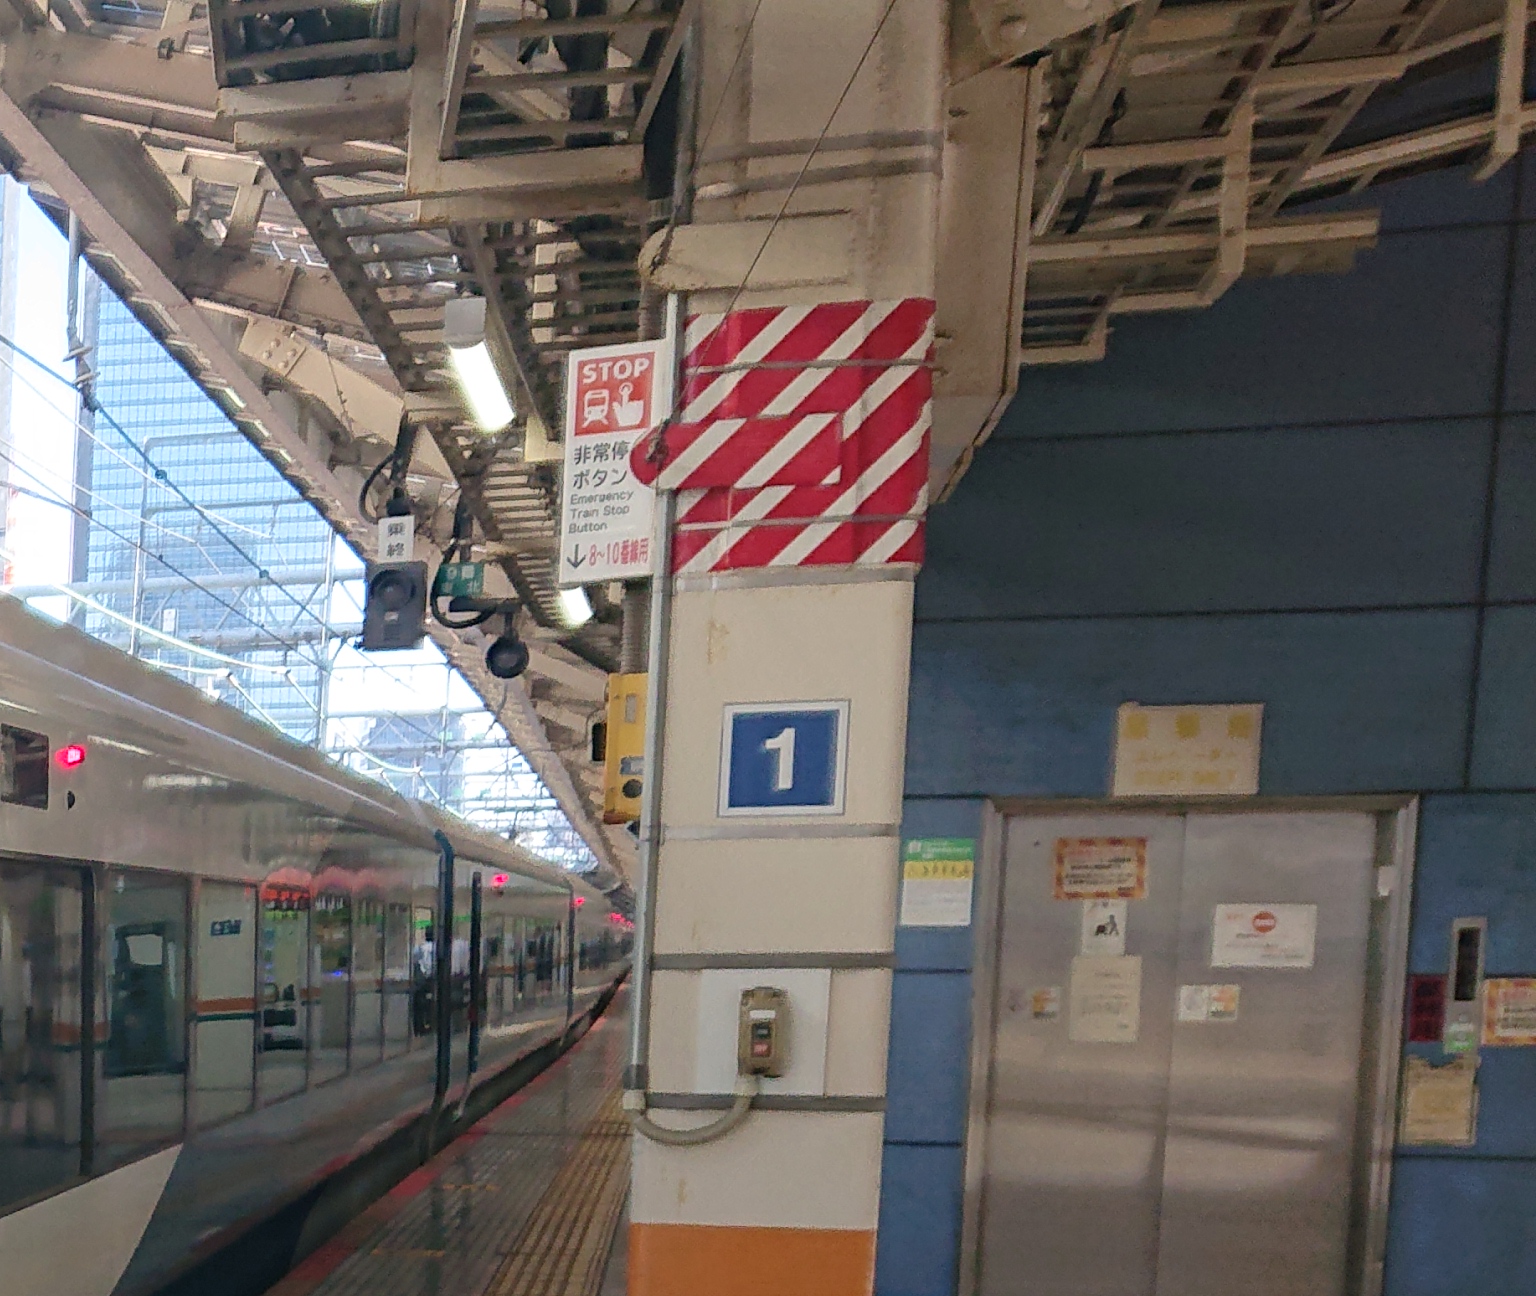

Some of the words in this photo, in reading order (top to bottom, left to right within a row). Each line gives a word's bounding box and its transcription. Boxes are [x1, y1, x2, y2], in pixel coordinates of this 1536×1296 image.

[581, 357, 650, 385] STOP
[573, 439, 630, 466] 非常停
[572, 468, 628, 490] ボタン
[570, 490, 634, 505] Emergency
[570, 508, 600, 520] Train
[603, 505, 630, 516] Stop
[568, 522, 608, 534] Button
[765, 727, 795, 789] 1
